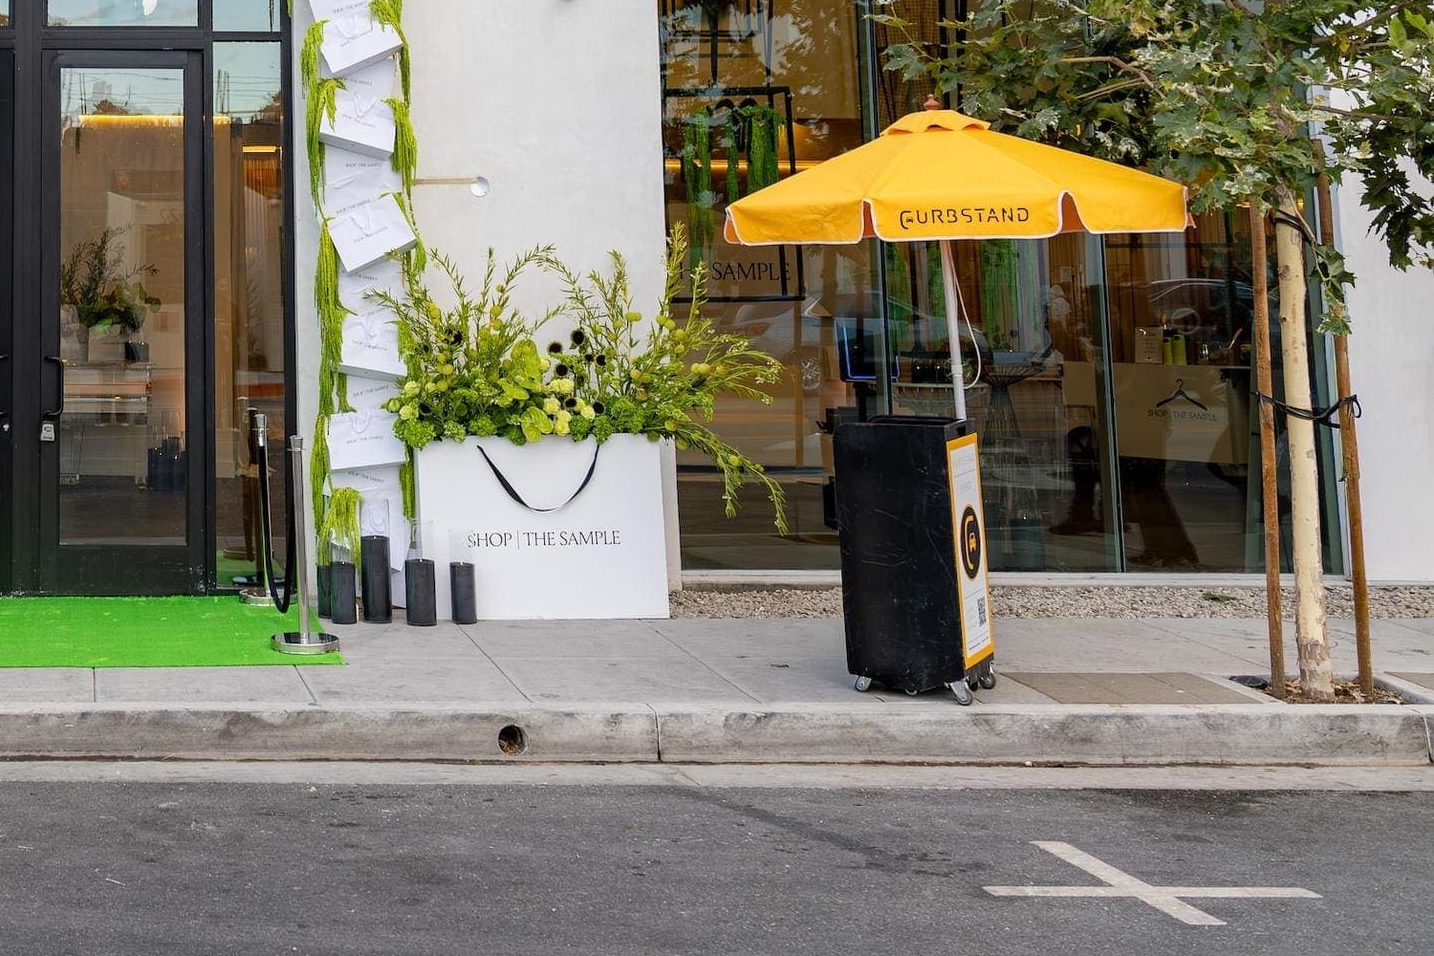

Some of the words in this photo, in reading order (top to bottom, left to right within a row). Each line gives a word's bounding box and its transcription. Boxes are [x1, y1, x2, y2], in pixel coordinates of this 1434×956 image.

[899, 207, 1029, 230] CURBSTAND
[467, 532, 513, 548] SHOP
[522, 531, 556, 546] THE
[559, 530, 621, 546] SAMPLE
